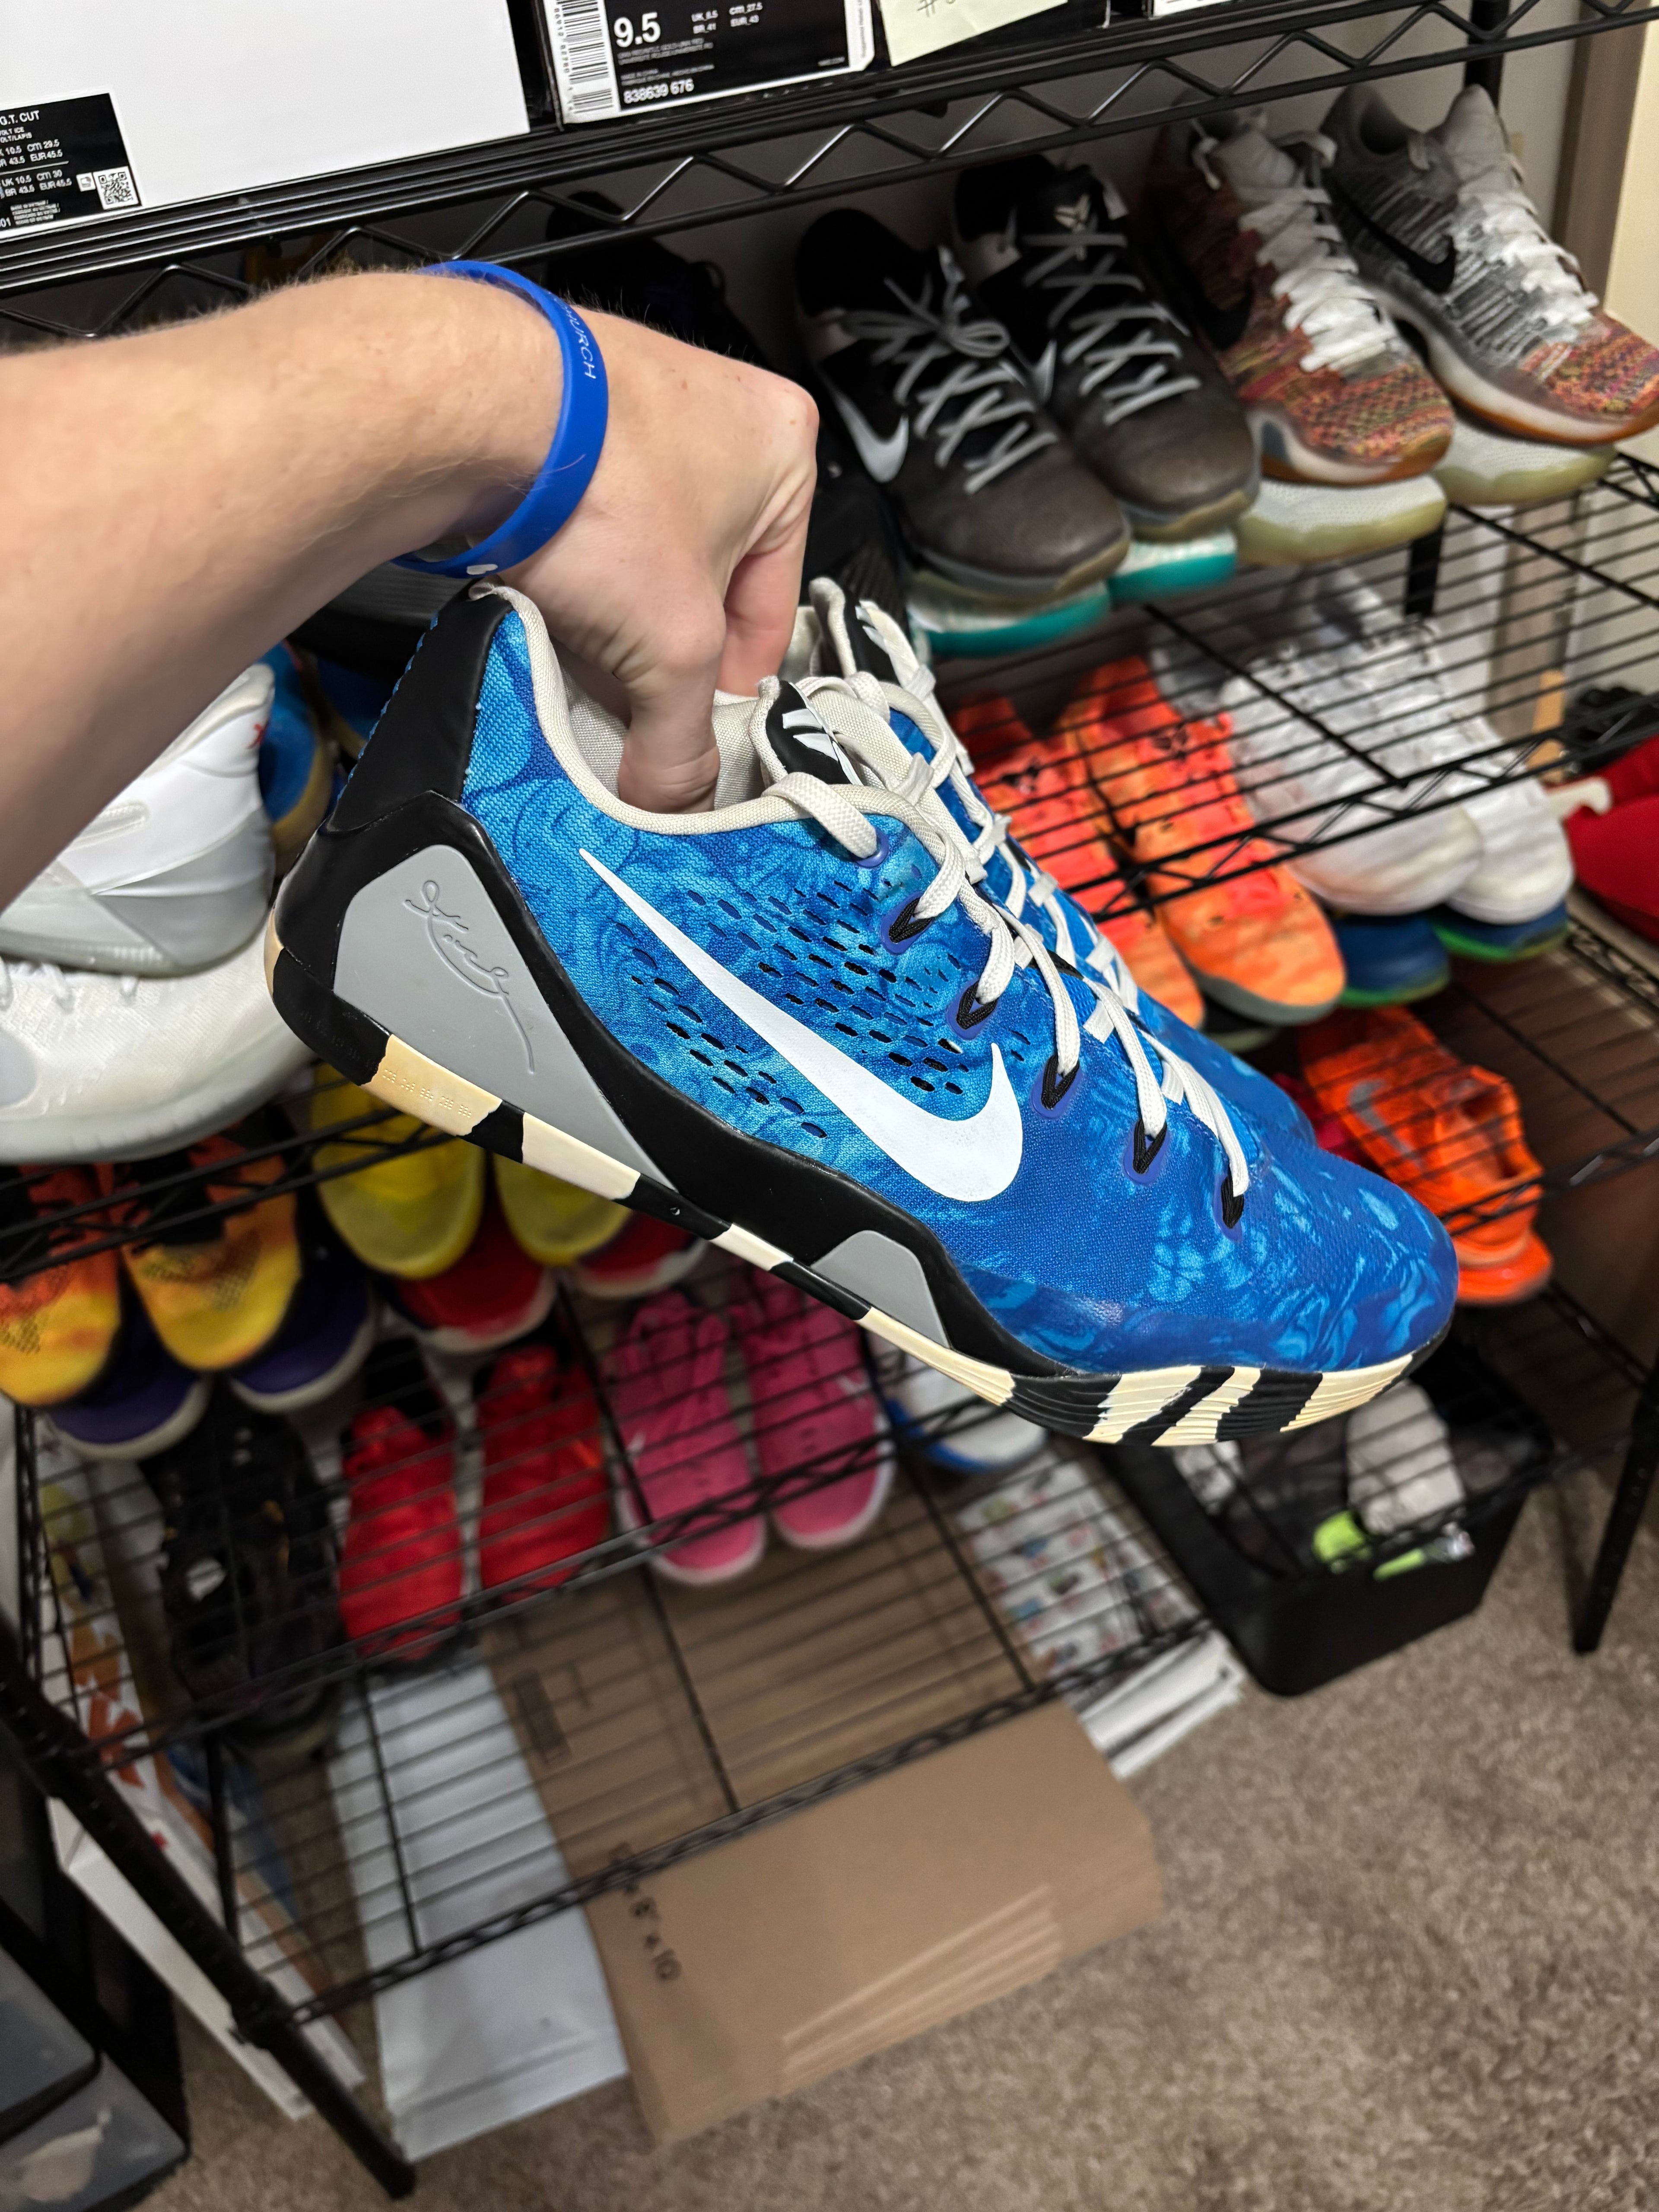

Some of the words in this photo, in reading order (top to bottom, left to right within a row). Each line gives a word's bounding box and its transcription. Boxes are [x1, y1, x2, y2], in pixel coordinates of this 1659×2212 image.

[613, 12, 661, 48] 9.5
[623, 83, 669, 104] 838639
[670, 78, 695, 95] 676
[19, 110, 40, 122] CUT
[5, 145, 22, 155] 10.5
[30, 152, 47, 162] EUR
[1, 178, 14, 187] UK
[15, 175, 32, 184] 10.5
